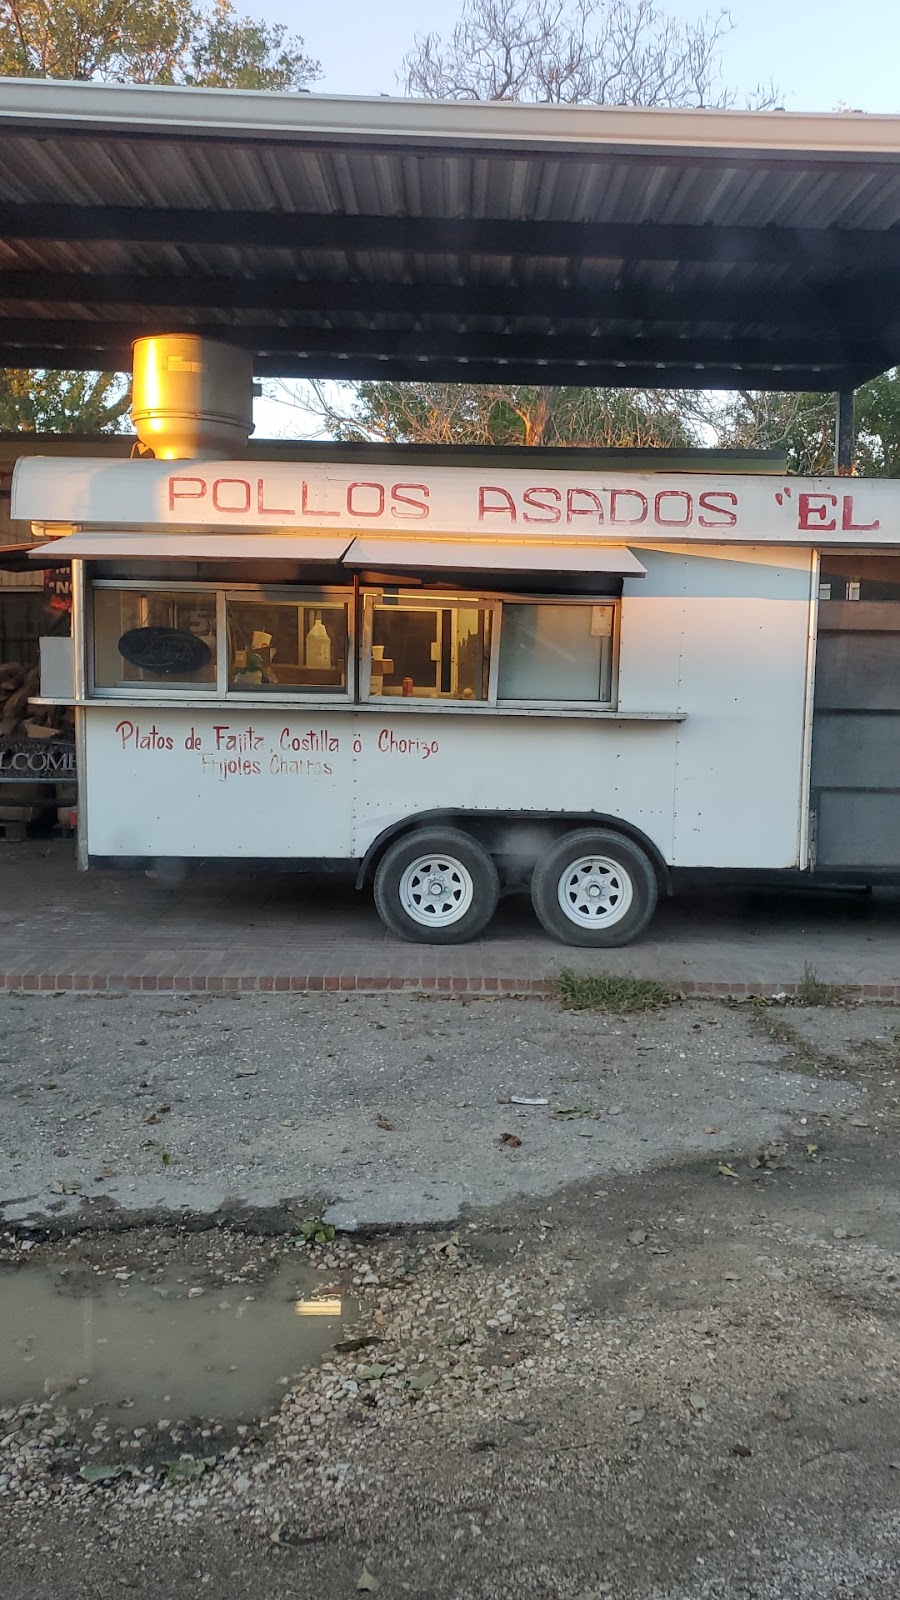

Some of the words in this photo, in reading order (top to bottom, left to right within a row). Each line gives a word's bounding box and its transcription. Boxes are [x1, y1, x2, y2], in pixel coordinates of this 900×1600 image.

[168, 476, 430, 520] POLLOS
[477, 486, 738, 528] ASADOS
[115, 720, 174, 750] Platos
[184, 727, 202, 751] de
[279, 727, 339, 753] Costilla
[378, 729, 439, 760] Chorizo
[199, 753, 262, 782] Frijoles
